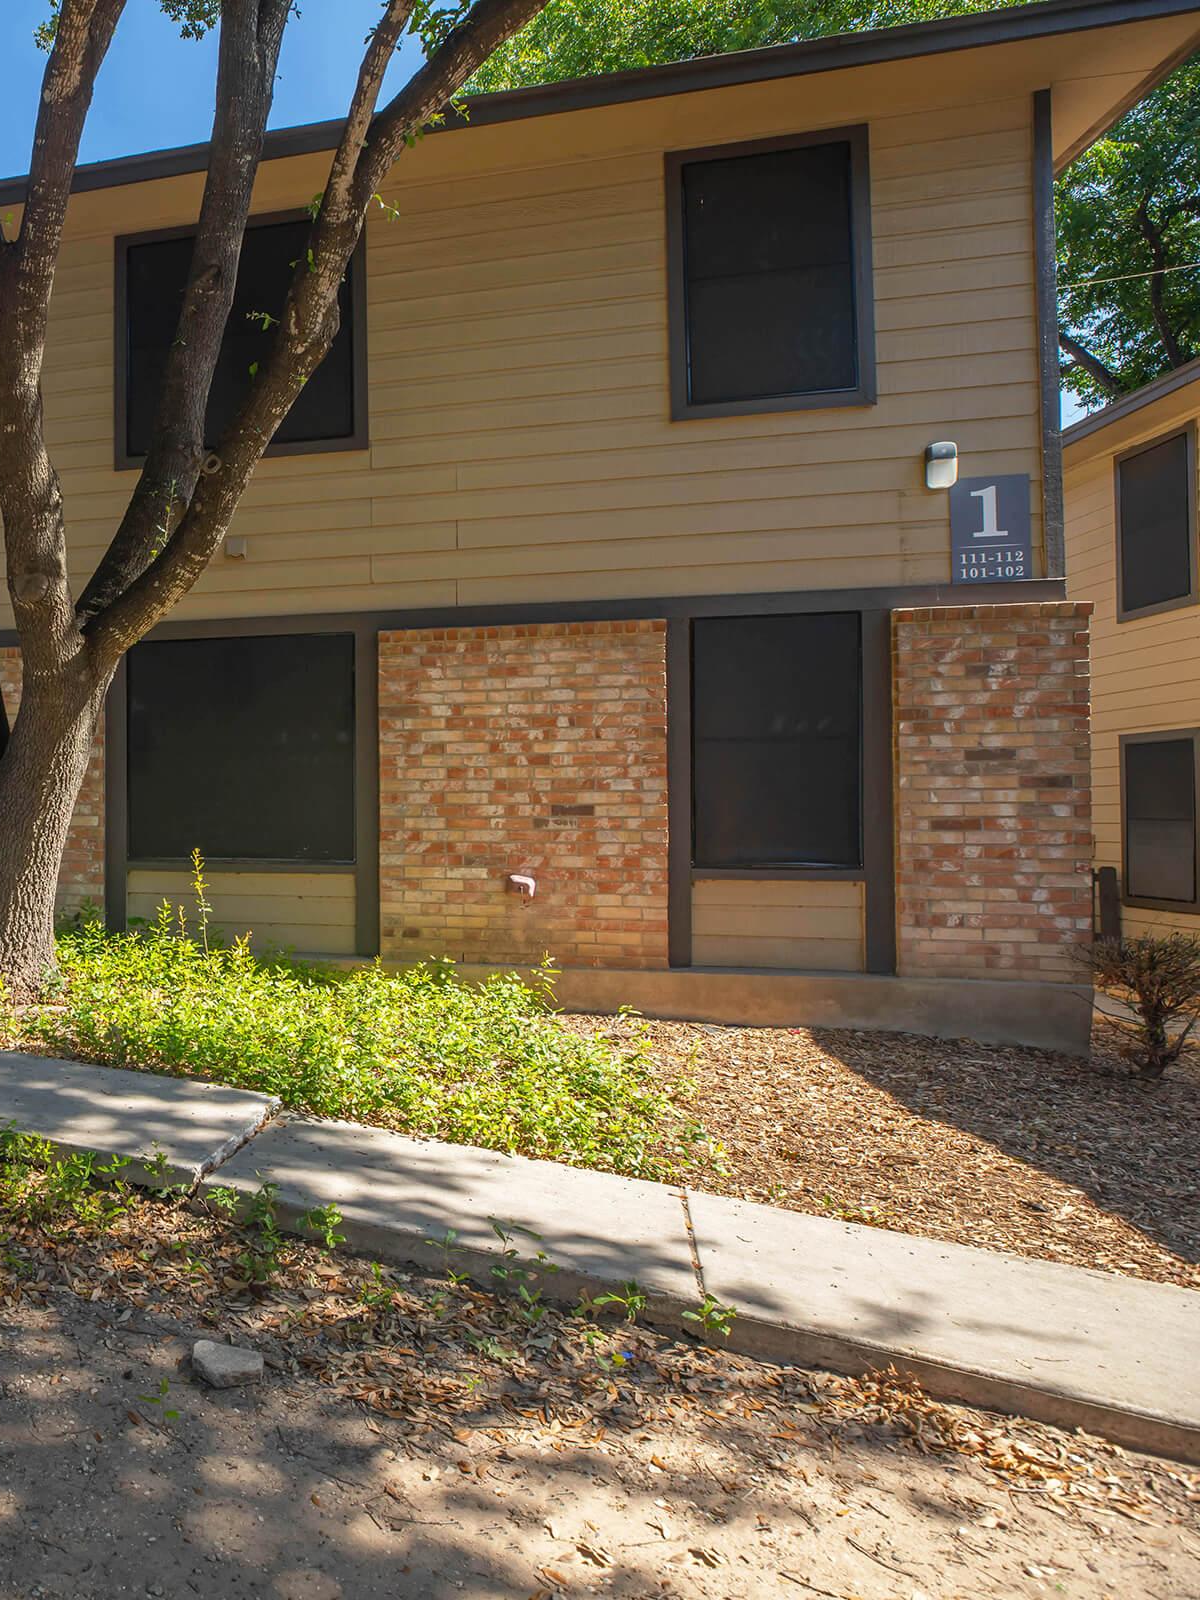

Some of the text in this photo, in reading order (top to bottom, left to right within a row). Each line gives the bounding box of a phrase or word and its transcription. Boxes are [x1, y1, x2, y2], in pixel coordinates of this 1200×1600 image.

[970, 485, 1008, 538] 1
[960, 551, 1024, 564] 111-112
[960, 566, 1024, 579] 101-102
